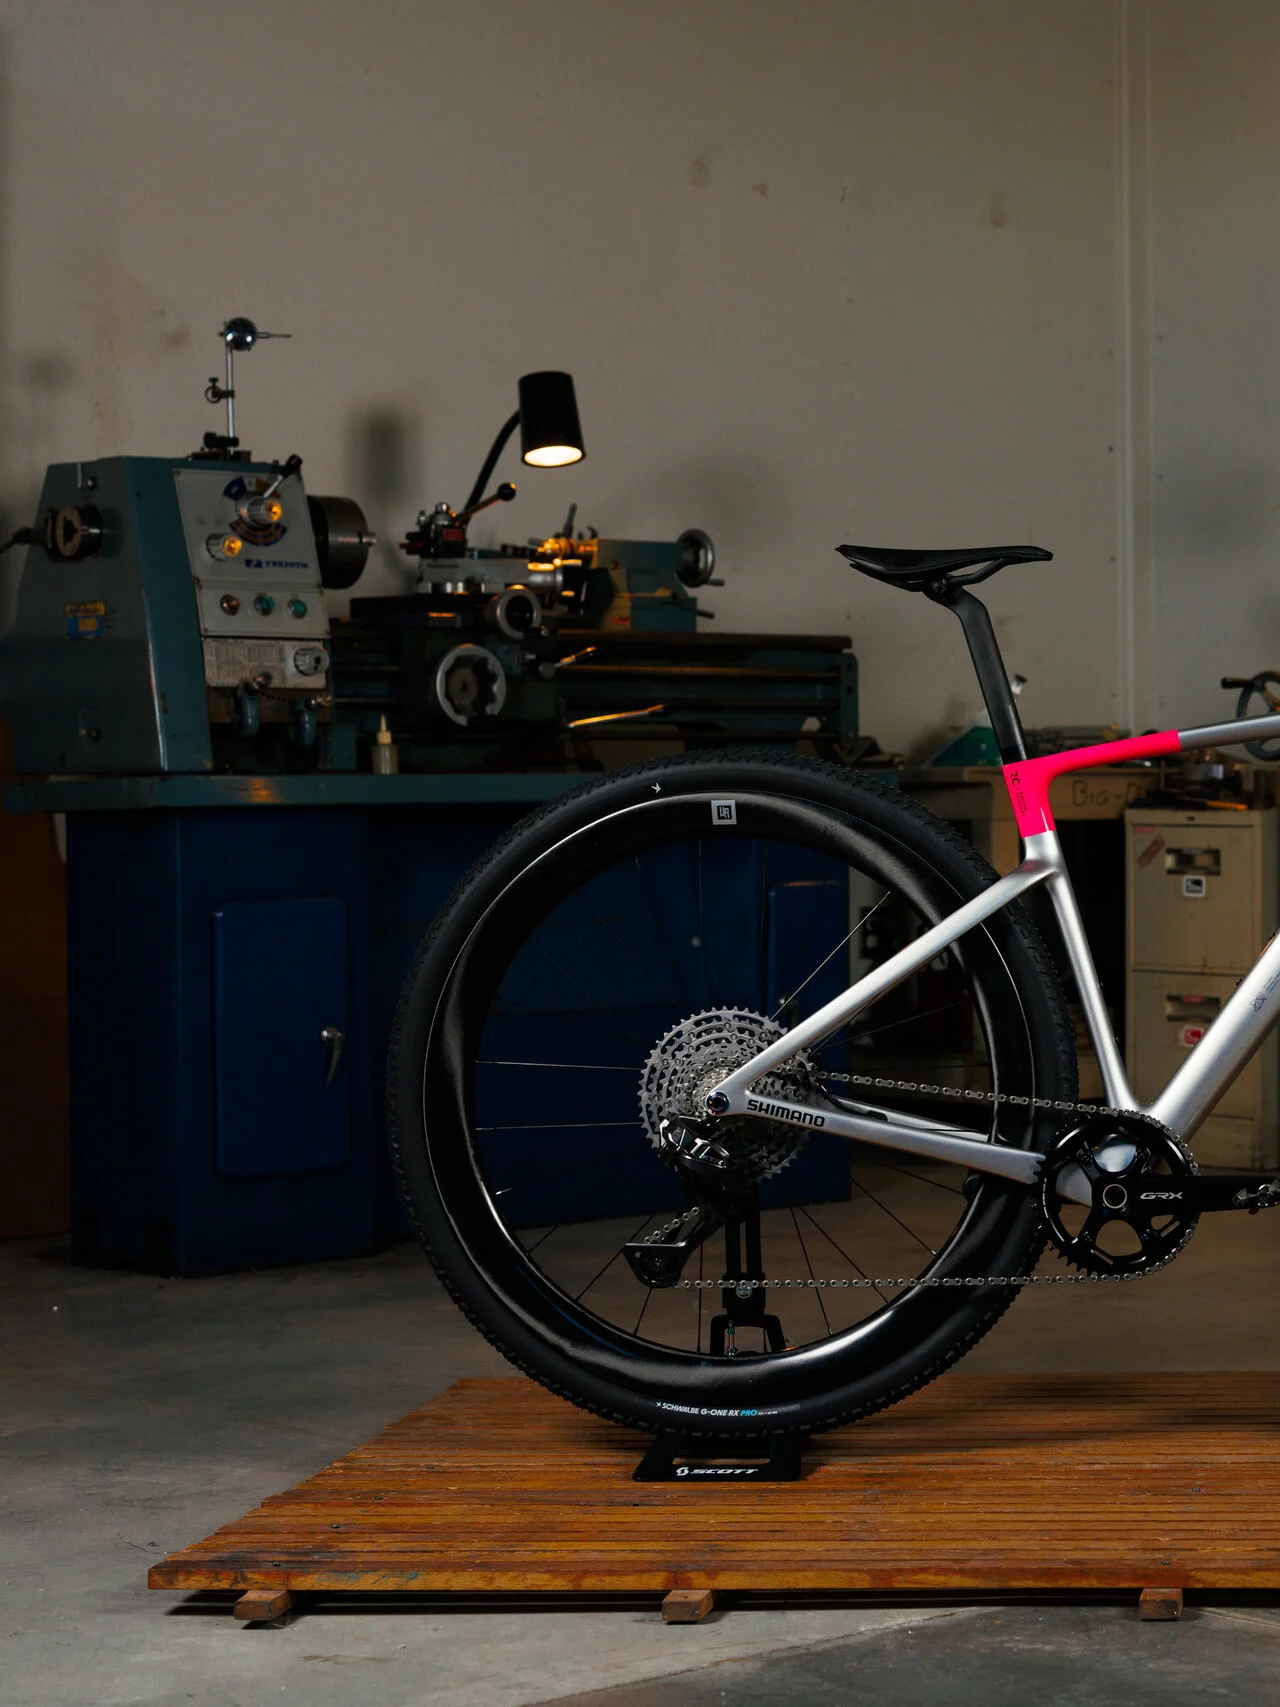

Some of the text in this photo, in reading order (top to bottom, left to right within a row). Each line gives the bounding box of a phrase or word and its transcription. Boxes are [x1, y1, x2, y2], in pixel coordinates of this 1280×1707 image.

[746, 1099, 826, 1128] SHIMANO
[1140, 1191, 1184, 1200] GRX
[662, 1402, 699, 1414] SCHWALBE
[700, 1408, 727, 1417] G-ONE
[728, 1409, 740, 1417] RX
